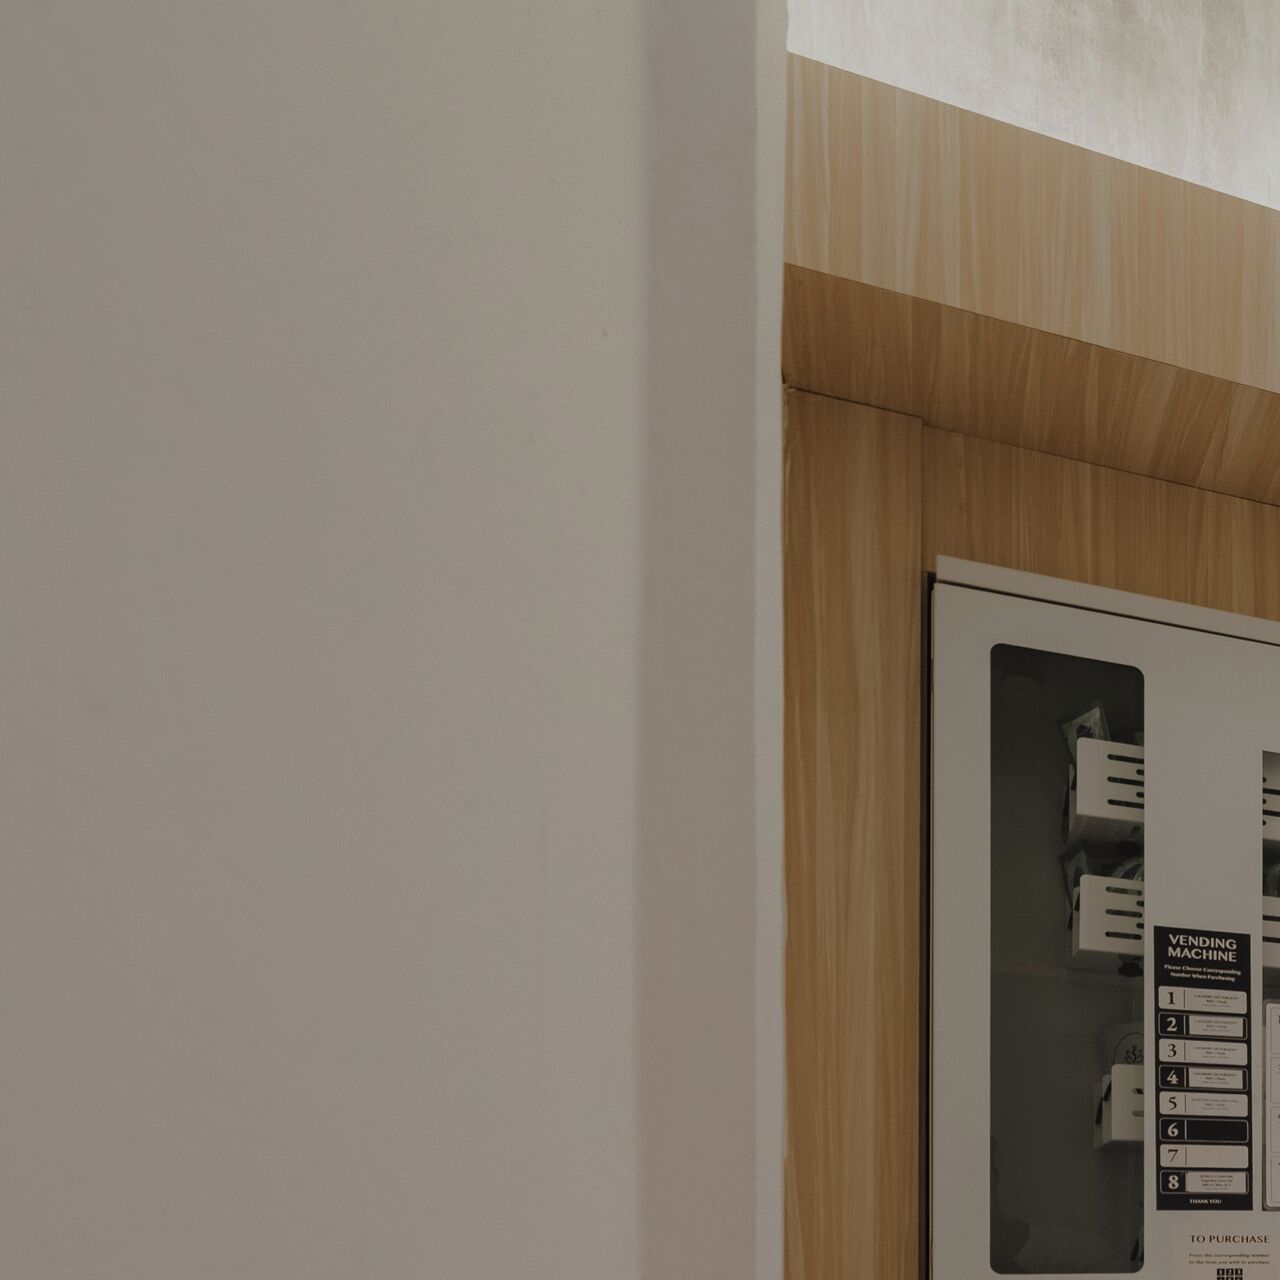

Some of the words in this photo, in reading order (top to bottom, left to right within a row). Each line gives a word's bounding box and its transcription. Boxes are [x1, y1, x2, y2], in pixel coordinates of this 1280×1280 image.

[1169, 934, 1237, 950] VENDING
[1168, 946, 1237, 963] MACHINE
[1164, 964, 1182, 972] Please
[1183, 966, 1202, 974] Choose
[1203, 967, 1241, 977] Corresponding
[1204, 974, 1235, 982] Purchasing
[1167, 991, 1175, 1005] 1
[1166, 1017, 1178, 1032] 2
[1167, 1044, 1177, 1058] 3
[1166, 1070, 1179, 1085] 4
[1168, 1097, 1177, 1111] 5
[1168, 1122, 1179, 1137] 6
[1168, 1149, 1178, 1163] 7
[1168, 1175, 1179, 1190] 8
[1190, 1235, 1206, 1244] TO
[1209, 1235, 1270, 1244] PURCHASE
